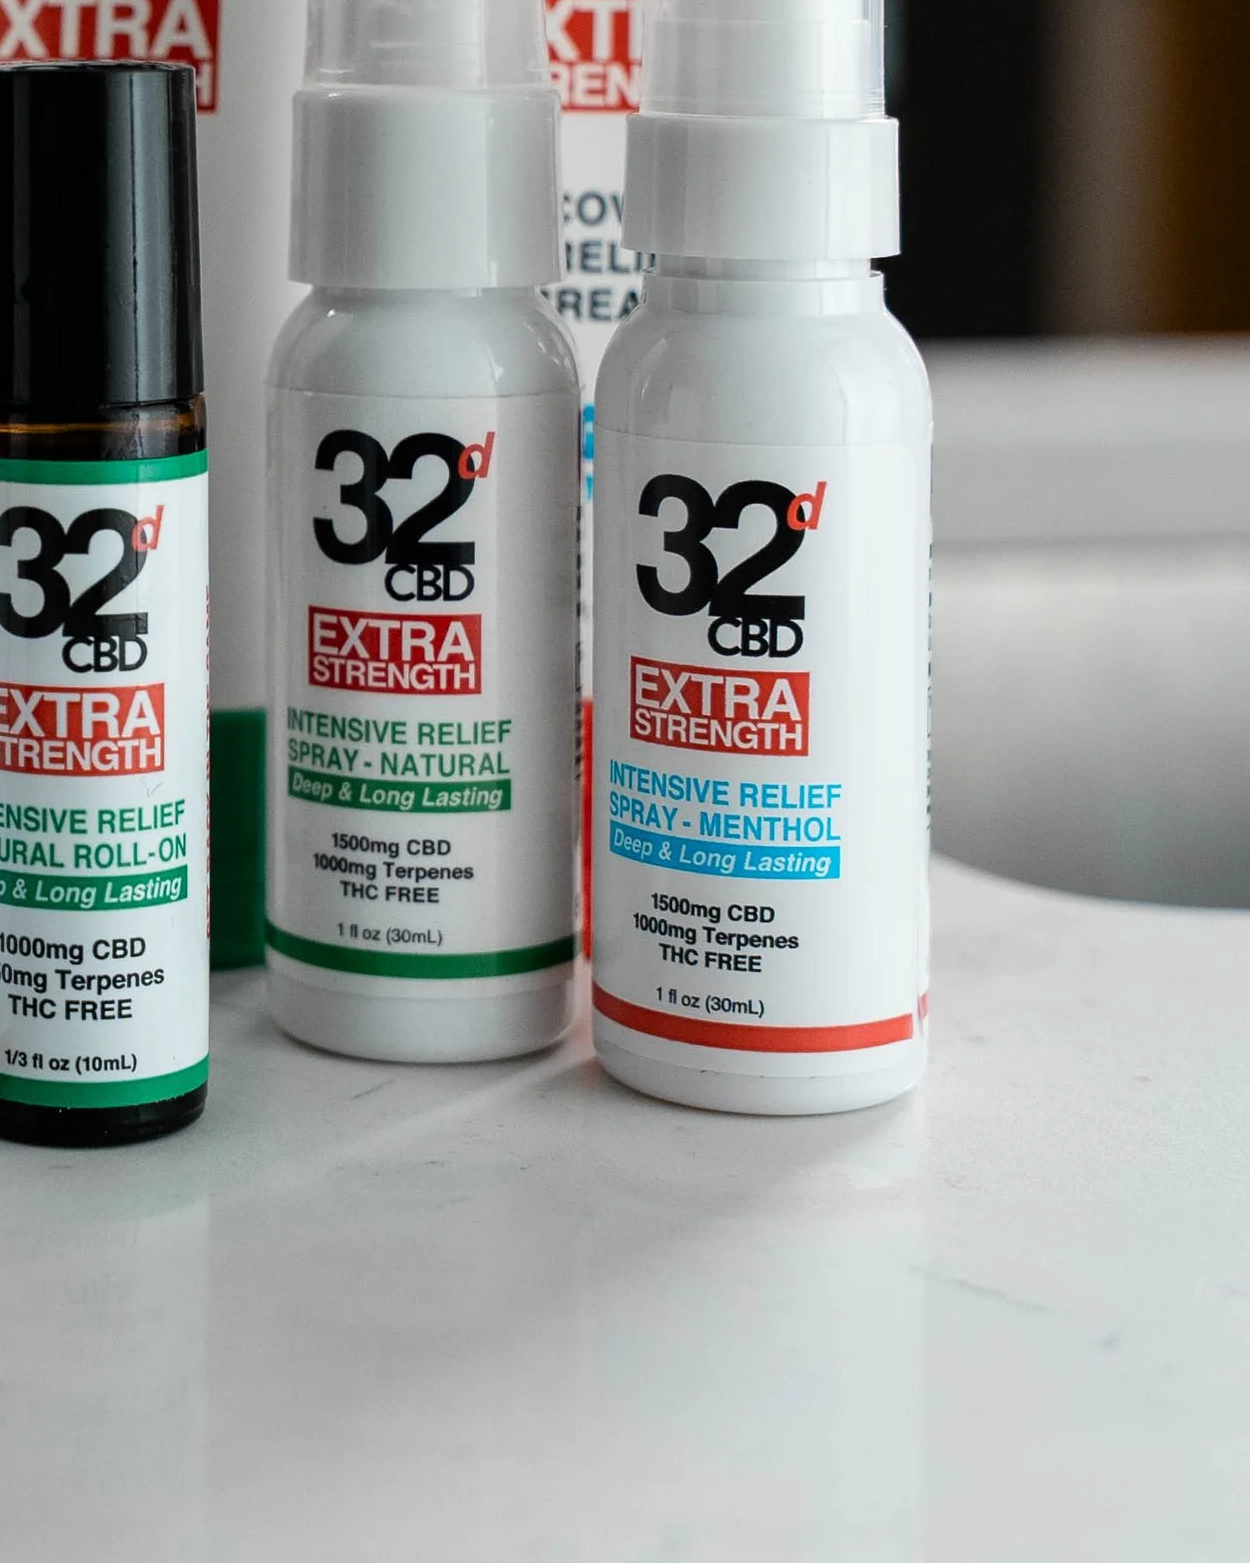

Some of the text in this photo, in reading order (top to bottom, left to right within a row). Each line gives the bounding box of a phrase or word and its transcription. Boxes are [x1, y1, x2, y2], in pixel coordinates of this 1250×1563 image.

[384, 563, 476, 603] CBD
[61, 634, 148, 674] CBD
[312, 612, 476, 663] EXTRA
[706, 615, 804, 658] CBD
[312, 654, 476, 691] STRENGTH
[634, 663, 803, 722] EXTRA
[287, 706, 513, 746] INTENSIVE RELIEF
[634, 708, 803, 751] STRENGTH
[287, 737, 359, 773] SPRAY
[380, 750, 511, 778] NATURAL
[291, 771, 503, 811] Deep & Long Lasting
[609, 759, 843, 810] INTENSIVE RELIEF
[98, 798, 186, 834] RELIEF
[609, 792, 679, 832] SPRAY
[699, 811, 841, 843] MENTHOL
[73, 832, 187, 869] ROLL-ON
[330, 832, 452, 859] 1500mg CBD
[613, 826, 832, 878] Deep & Long Lasting
[312, 852, 475, 884] 1000mg Terpenes
[12, 878, 27, 900] &
[35, 880, 97, 909] Long
[104, 876, 183, 904] Lasting
[339, 880, 440, 904] THC FREE
[650, 892, 776, 924] 1500mg CBD
[92, 936, 146, 961] CBD
[337, 923, 444, 947] 1 fl oz (30mL)
[632, 912, 800, 952] 1000mg Terpenes
[658, 942, 763, 973] THC FREE
[54, 967, 165, 996] Terpenes
[8, 993, 133, 1021] THC FREE
[656, 986, 766, 1018] 1 fl oz (30mL)
[4, 1048, 138, 1075] 1/3 fl oz (10mL)
